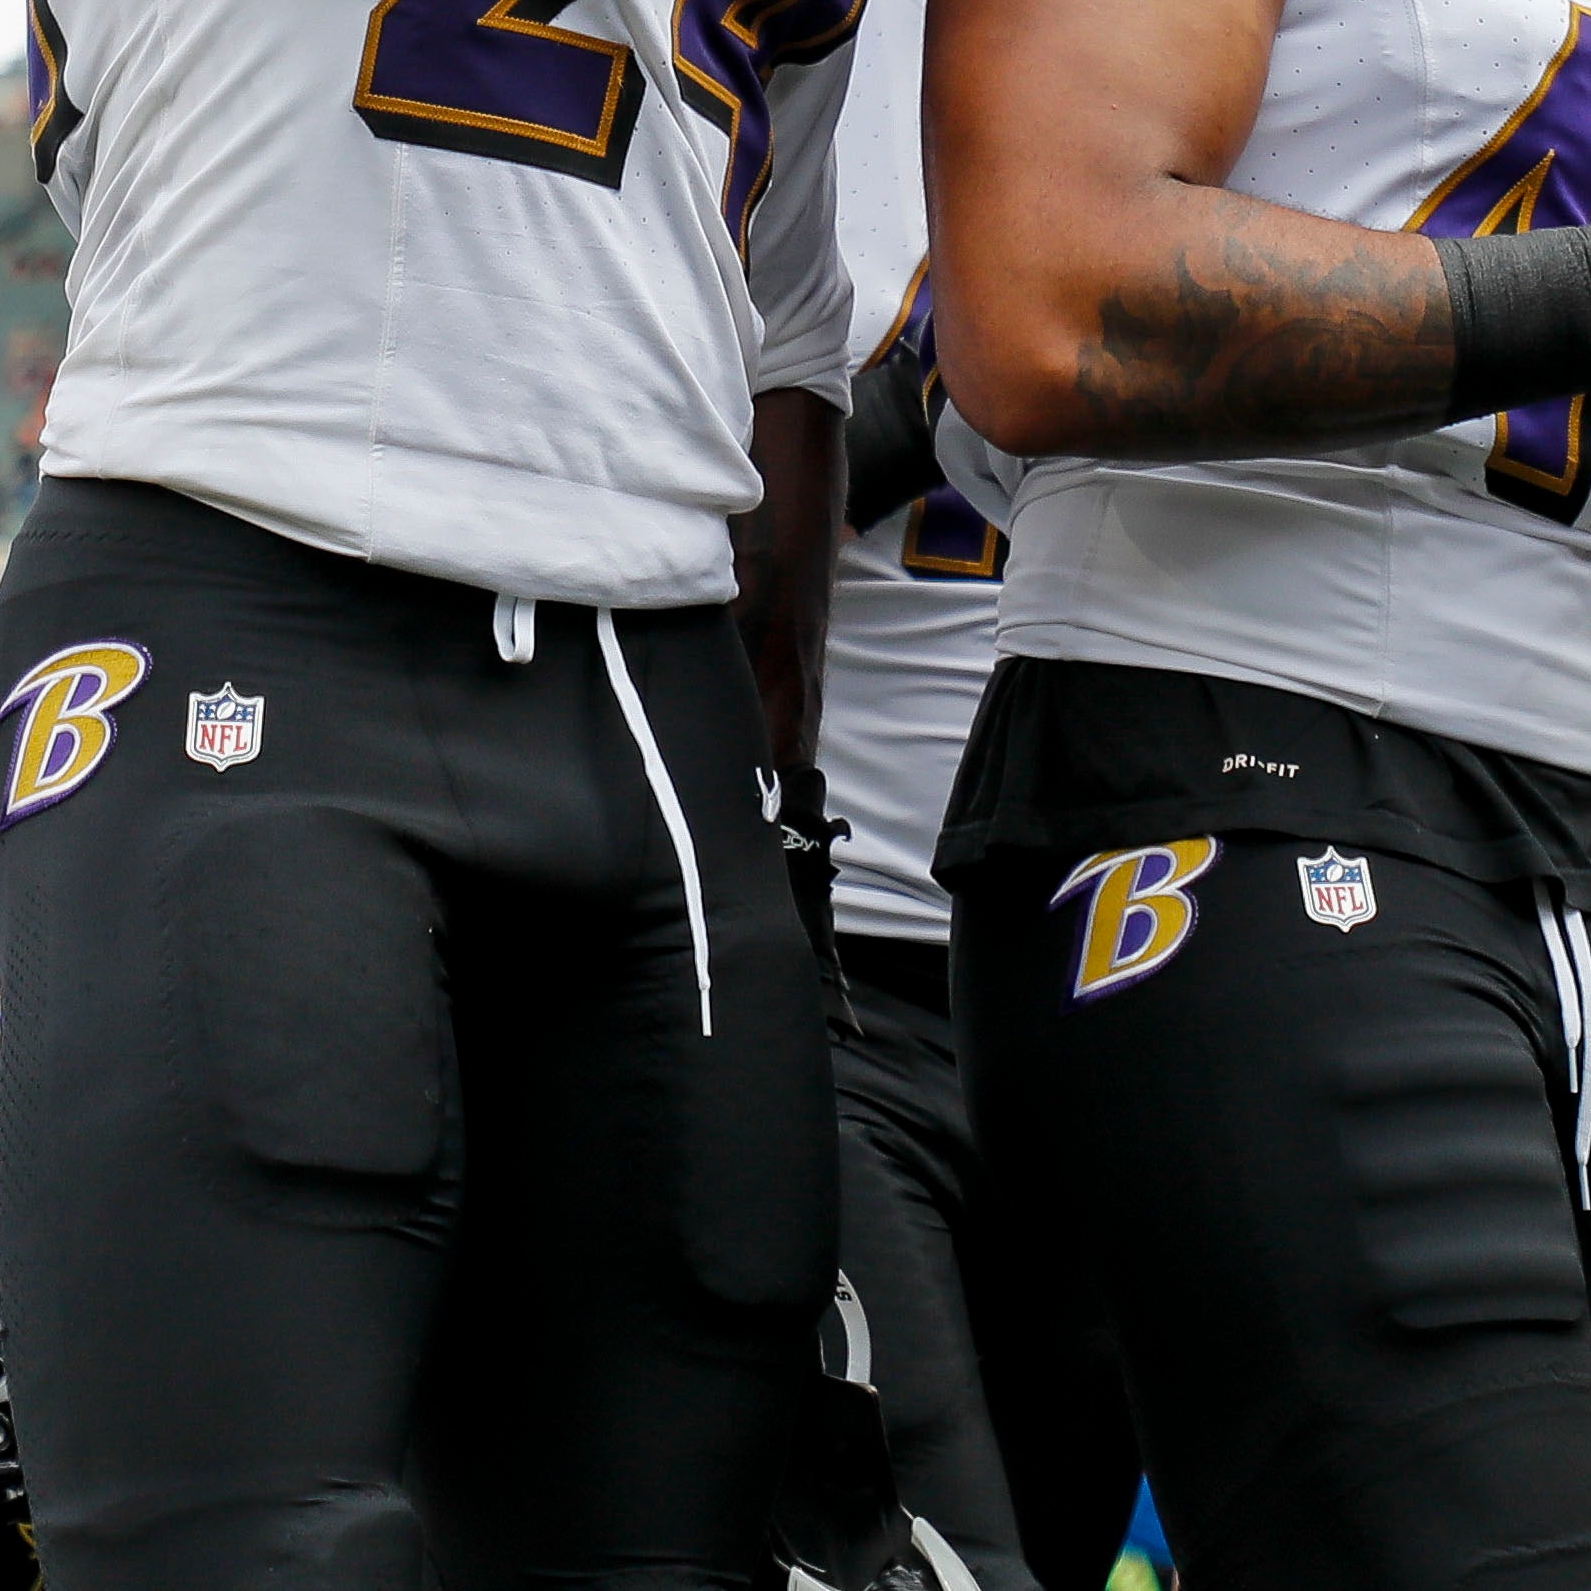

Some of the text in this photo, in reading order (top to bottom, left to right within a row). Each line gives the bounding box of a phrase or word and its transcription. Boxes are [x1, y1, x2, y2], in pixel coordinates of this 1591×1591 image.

[199, 724, 248, 755] NFL
[1221, 753, 1300, 779] DRI-FIT
[1314, 885, 1364, 916] NFL
